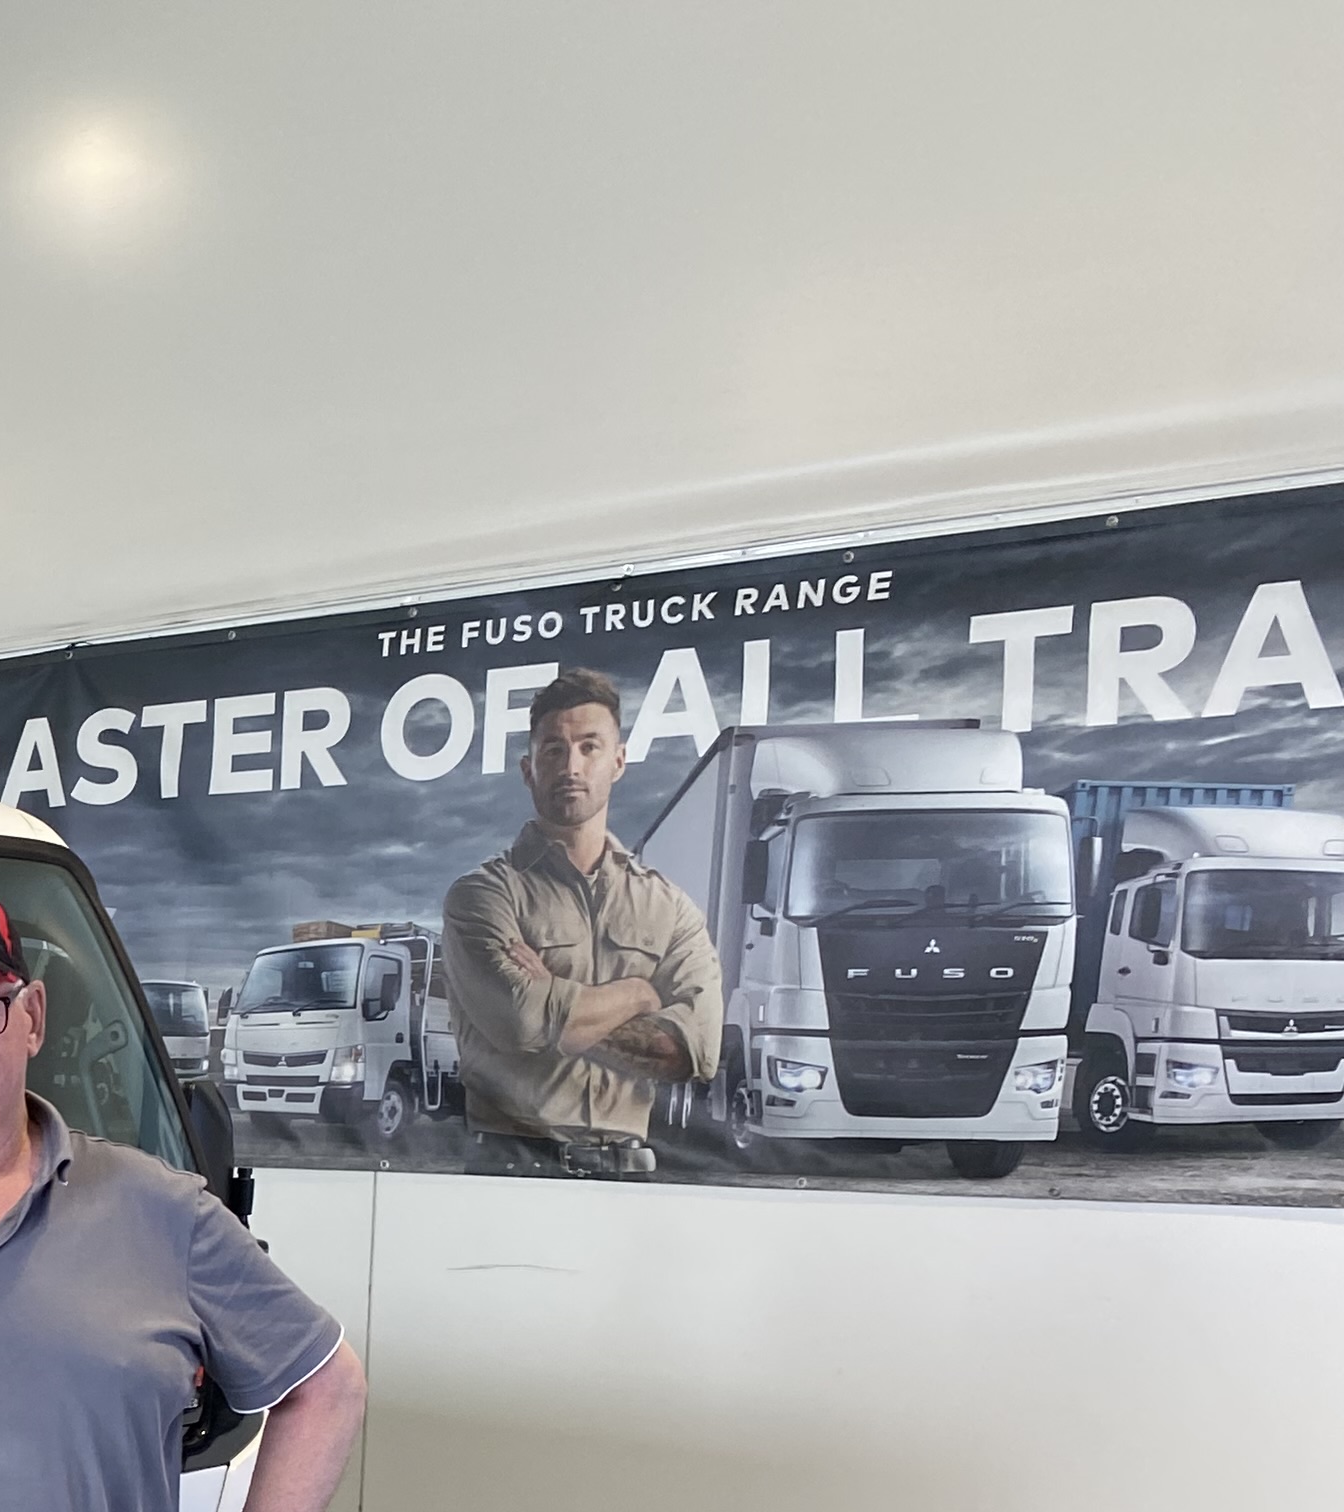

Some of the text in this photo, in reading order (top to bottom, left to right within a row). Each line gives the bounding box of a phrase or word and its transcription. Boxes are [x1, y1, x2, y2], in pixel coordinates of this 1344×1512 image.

[377, 569, 895, 657] THE FUSO TRUCK RANGE
[379, 662, 559, 783] OF
[968, 580, 1344, 733] TRA
[846, 966, 1014, 980] FUSO
